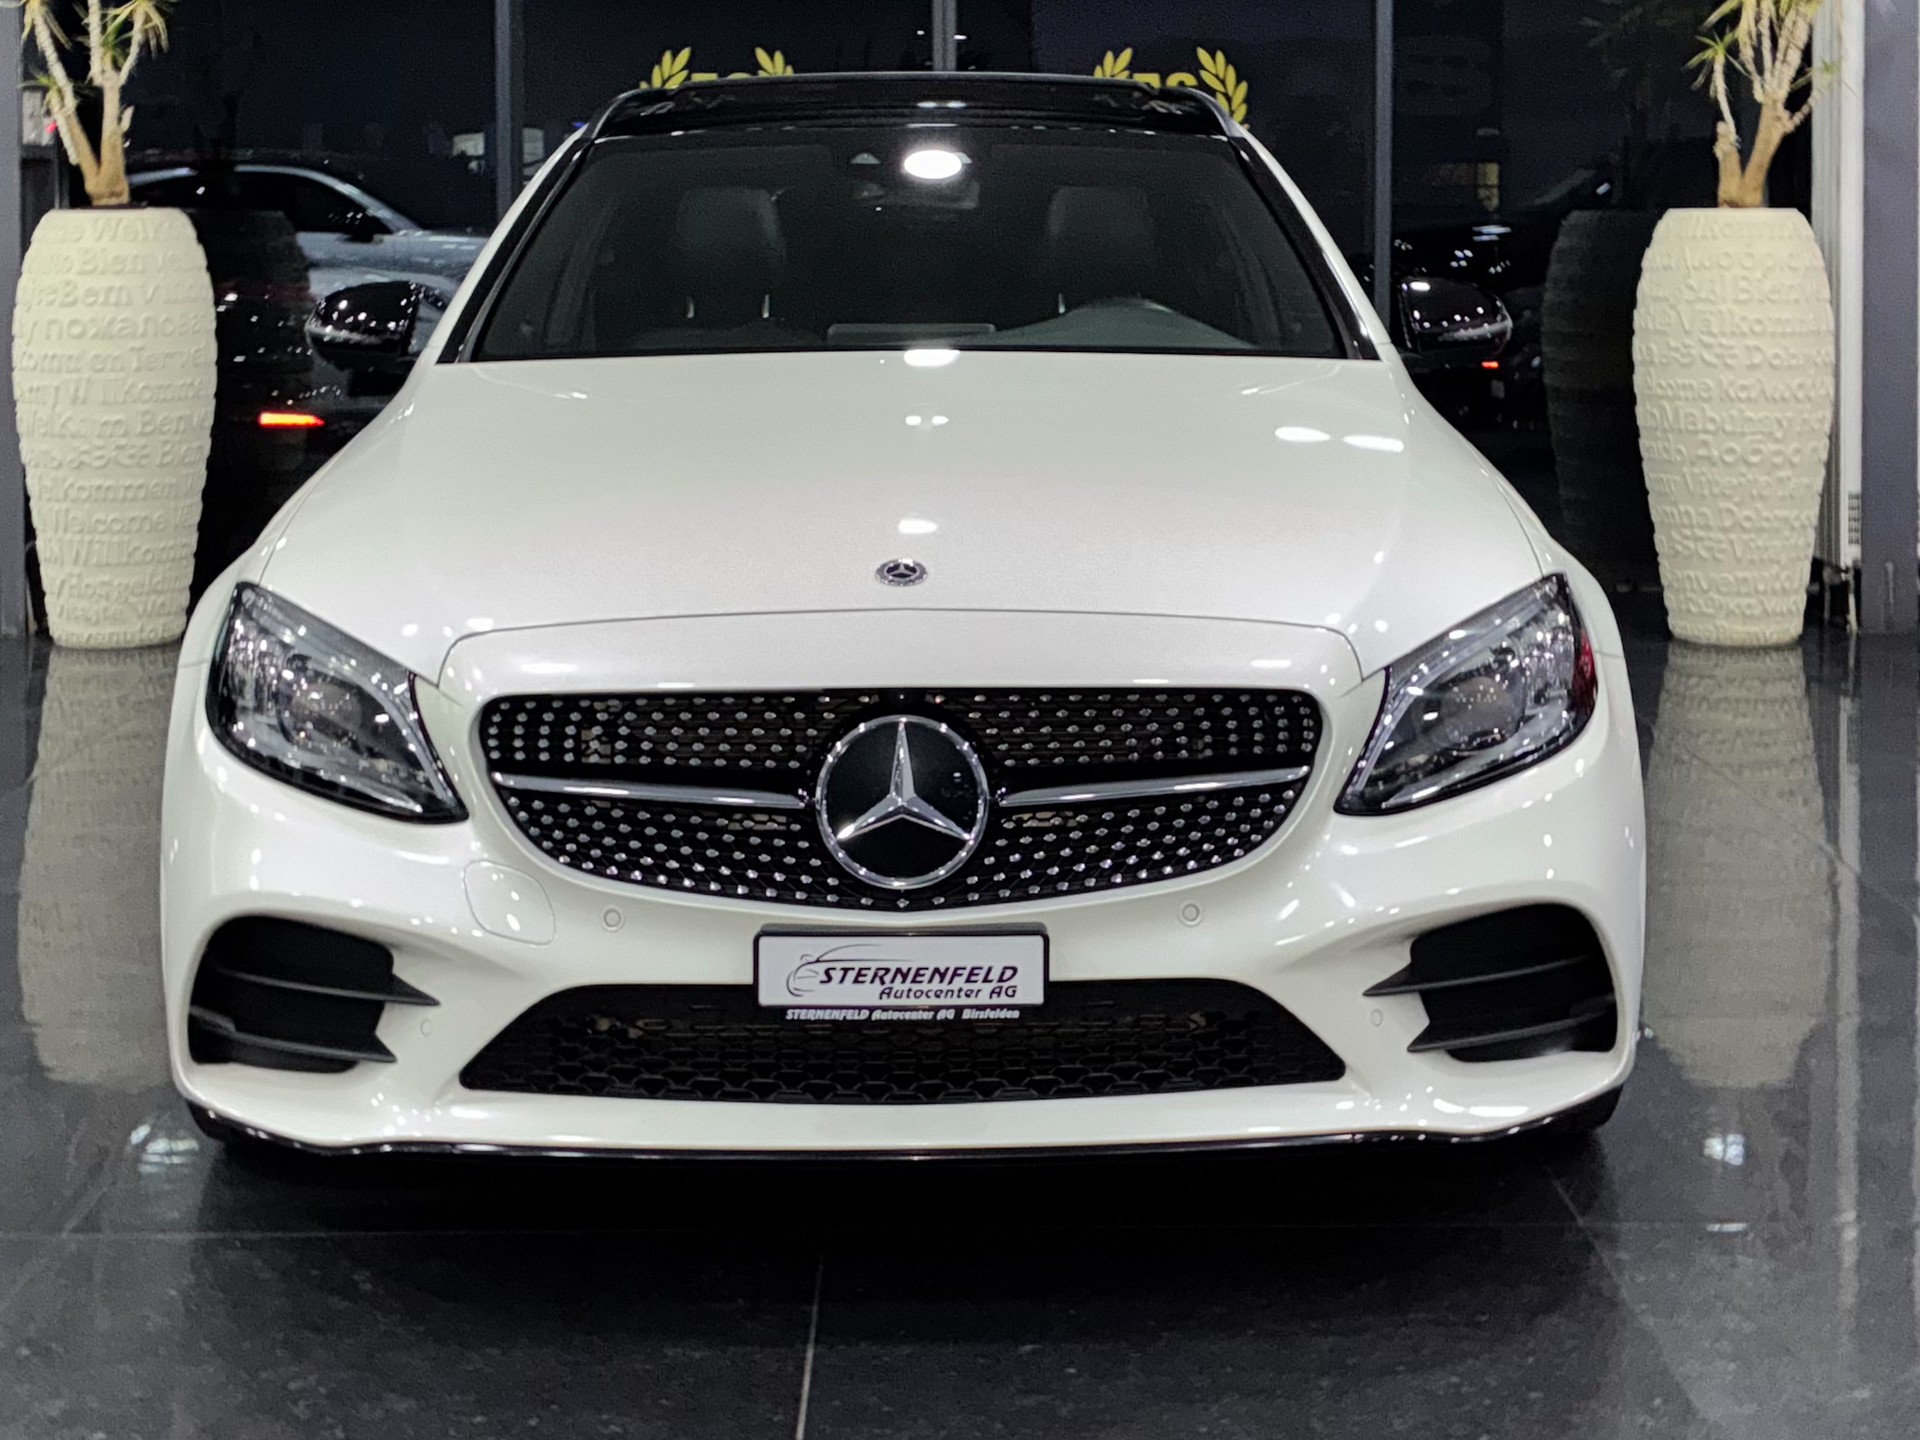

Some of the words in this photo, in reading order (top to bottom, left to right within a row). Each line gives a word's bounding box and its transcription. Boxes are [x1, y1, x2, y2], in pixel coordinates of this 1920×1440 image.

[820, 966, 1018, 986] STERNENFELD
[879, 986, 982, 1000] Autocenter
[989, 985, 1018, 999] AG
[786, 1008, 869, 1021] STERNENFELD
[871, 1008, 935, 1021] Autocenter
[936, 1008, 955, 1020] AG
[961, 1008, 1020, 1020] Birsfelden
